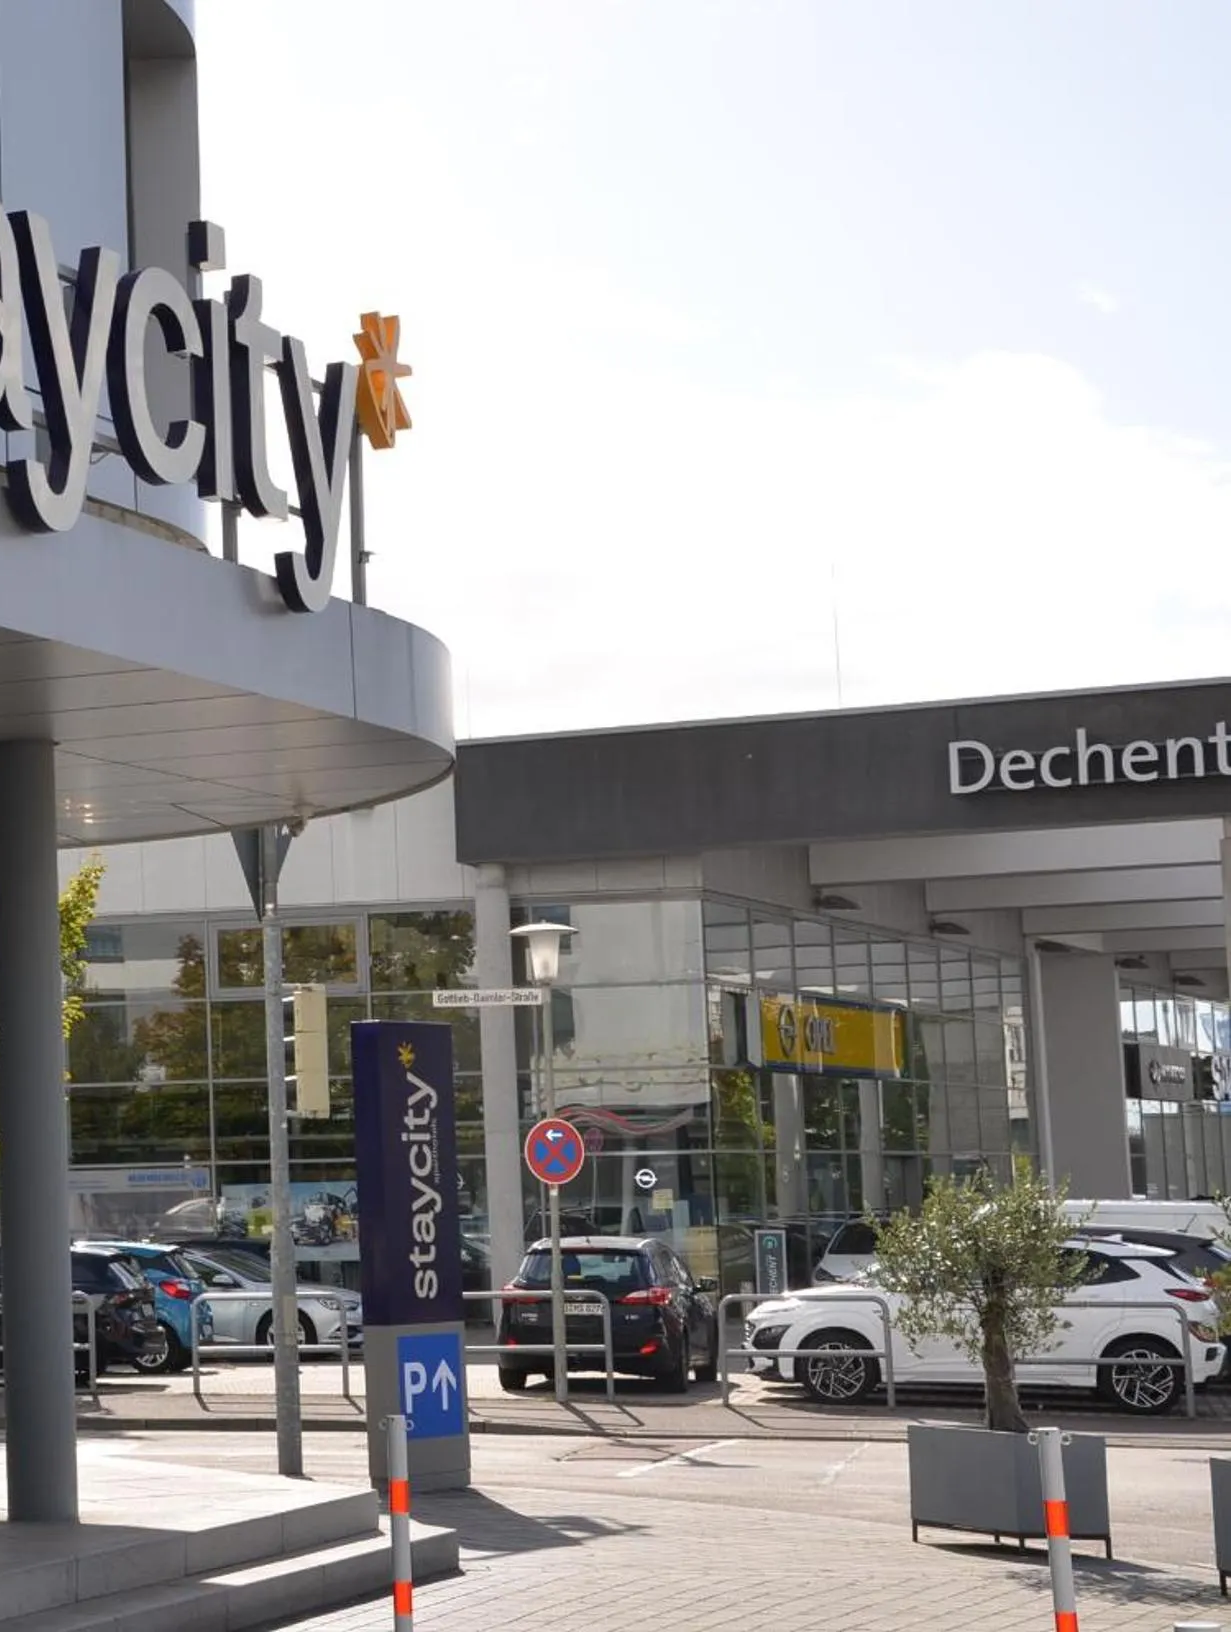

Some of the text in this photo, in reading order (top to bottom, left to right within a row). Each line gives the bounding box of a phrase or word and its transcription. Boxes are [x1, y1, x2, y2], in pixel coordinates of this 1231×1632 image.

[948, 721, 1231, 794] Dechent
[401, 1071, 442, 1300] staycity
[404, 1362, 427, 1414] P
